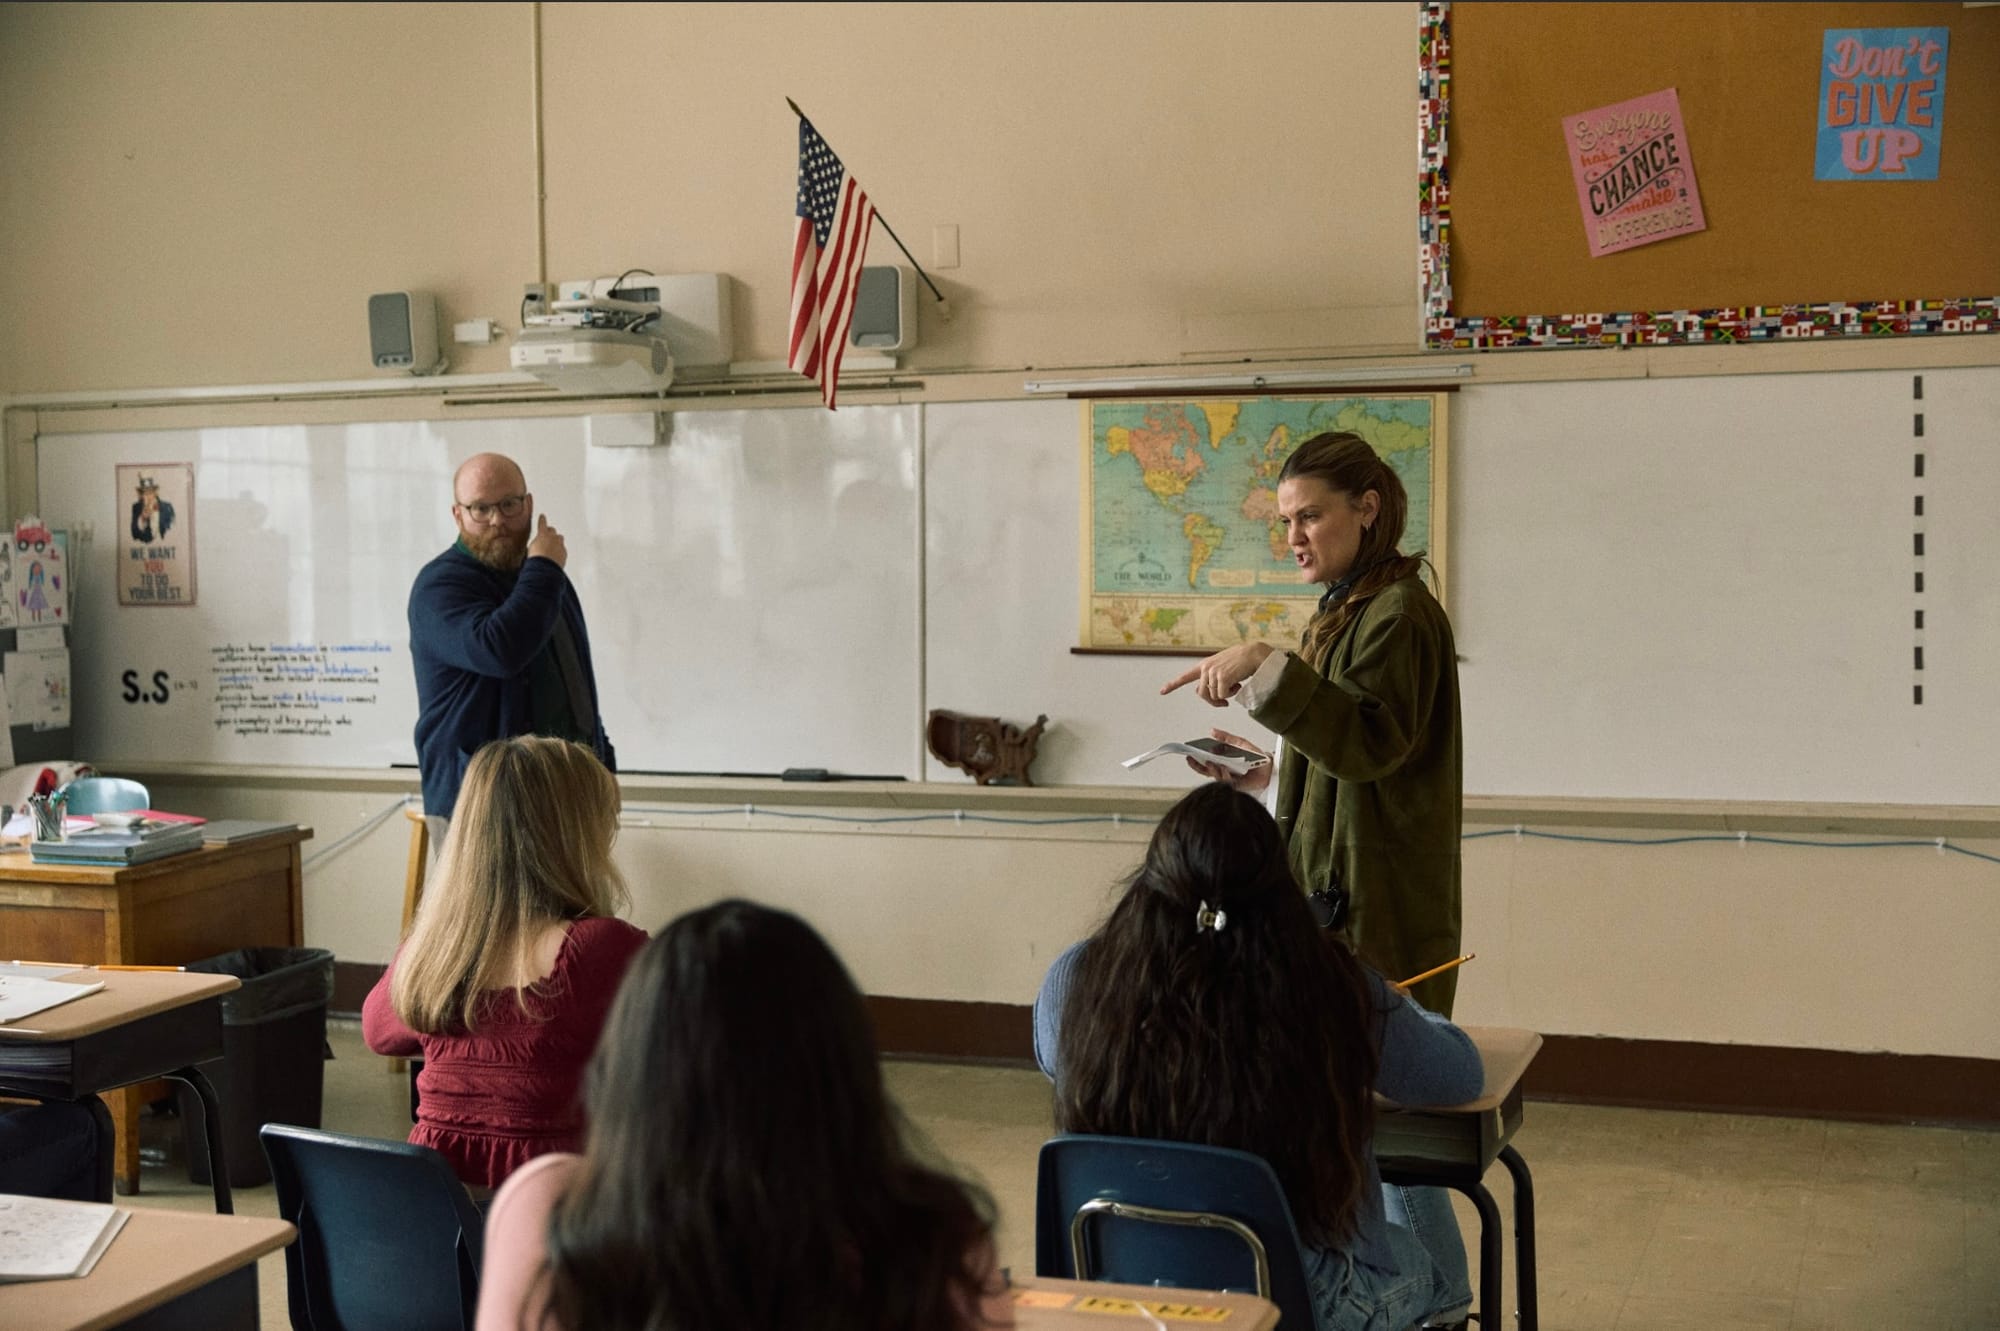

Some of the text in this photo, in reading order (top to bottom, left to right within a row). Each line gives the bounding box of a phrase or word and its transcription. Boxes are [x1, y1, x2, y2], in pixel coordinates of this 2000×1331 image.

[1828, 36, 1941, 80] Don't
[1827, 79, 1936, 128] GIVE
[1574, 110, 1671, 151] Everyone
[1580, 145, 1628, 168] has a
[1840, 127, 1923, 174] UP
[1588, 132, 1680, 216] CHANCE
[1655, 177, 1670, 189] to
[1617, 186, 1676, 215] make
[1597, 202, 1695, 248] DIFFERENCE
[130, 546, 176, 560] WE WANT
[143, 559, 165, 573] YOU
[140, 573, 170, 587] TO DO
[1138, 571, 1172, 581] WORLD
[128, 586, 181, 600] YOUR BEST
[121, 668, 170, 704] S.S
